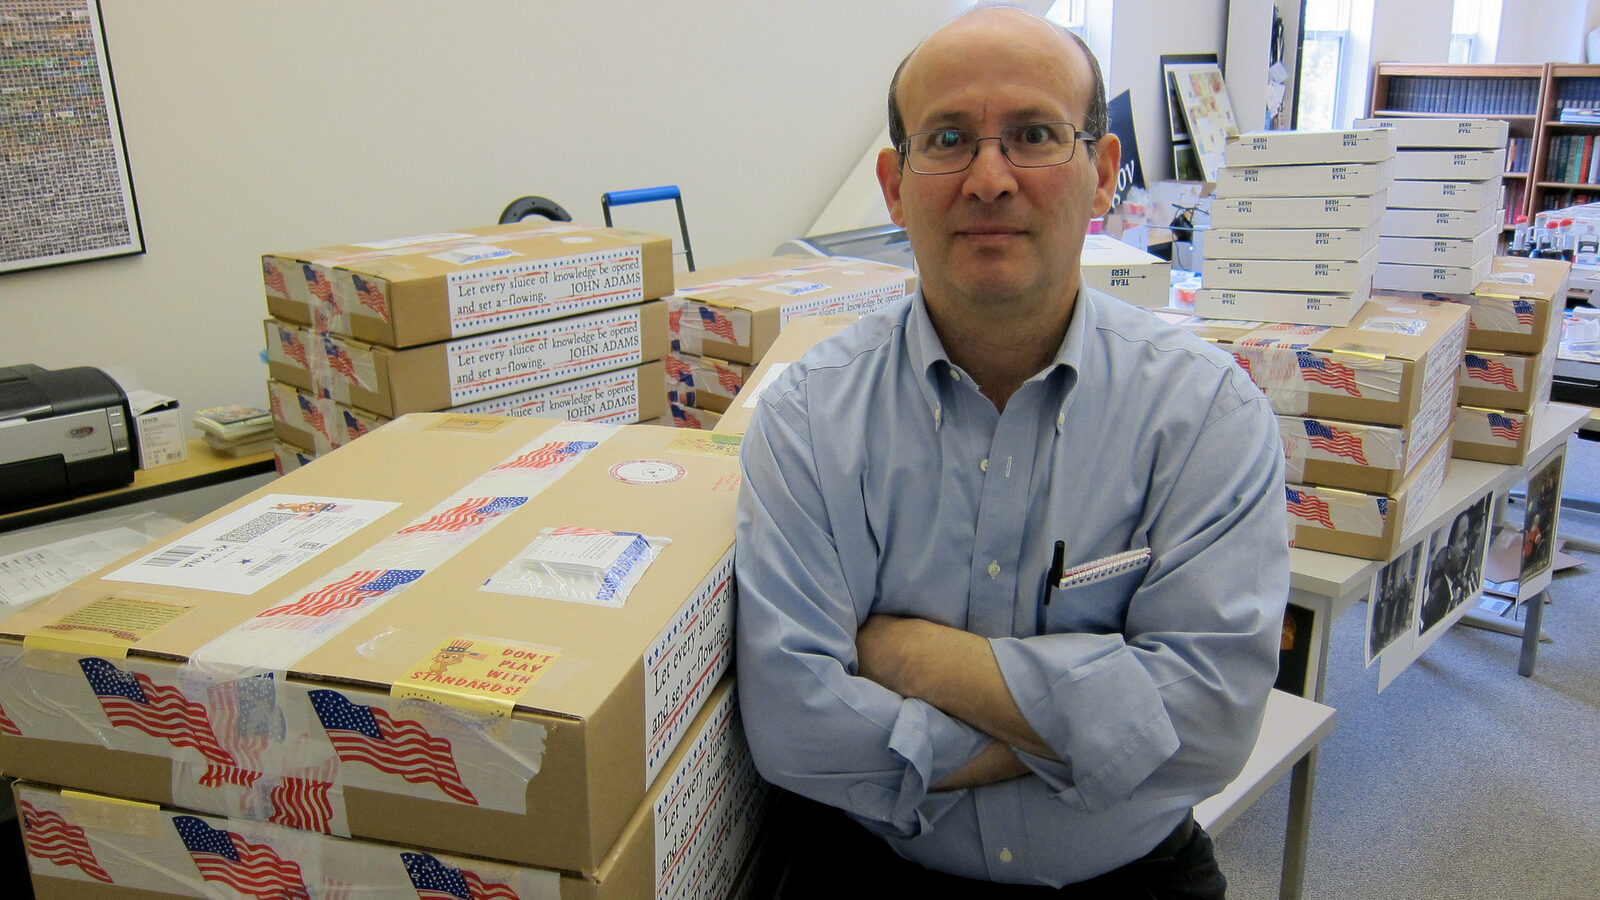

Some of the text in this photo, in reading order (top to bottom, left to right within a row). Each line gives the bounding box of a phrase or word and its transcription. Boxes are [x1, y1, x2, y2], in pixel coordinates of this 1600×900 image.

[457, 272, 640, 314] and set a-flowing. JOHN ADAMS
[458, 258, 639, 297] Let every sluice of knowledge be opened
[457, 335, 639, 384] and set a-flowing. JOHN ADAMS
[458, 321, 638, 367] Let every sluice of knowledge be opened
[536, 401, 545, 413] of
[550, 393, 592, 410] knowledge
[594, 388, 605, 399] be
[607, 381, 635, 397] opened
[567, 394, 637, 420] JOHN ADAMS
[501, 648, 553, 663] DON'T
[654, 584, 731, 696] Let every sluice of
[410, 671, 522, 696] STANDARDS!
[486, 670, 532, 684] WITH
[498, 660, 542, 673] PLAY
[652, 694, 669, 735] and
[671, 683, 683, 707] set
[664, 806, 679, 840] Let
[682, 764, 704, 808] every
[707, 728, 727, 767] sluice
[661, 834, 677, 875] and
[680, 814, 692, 842] set
